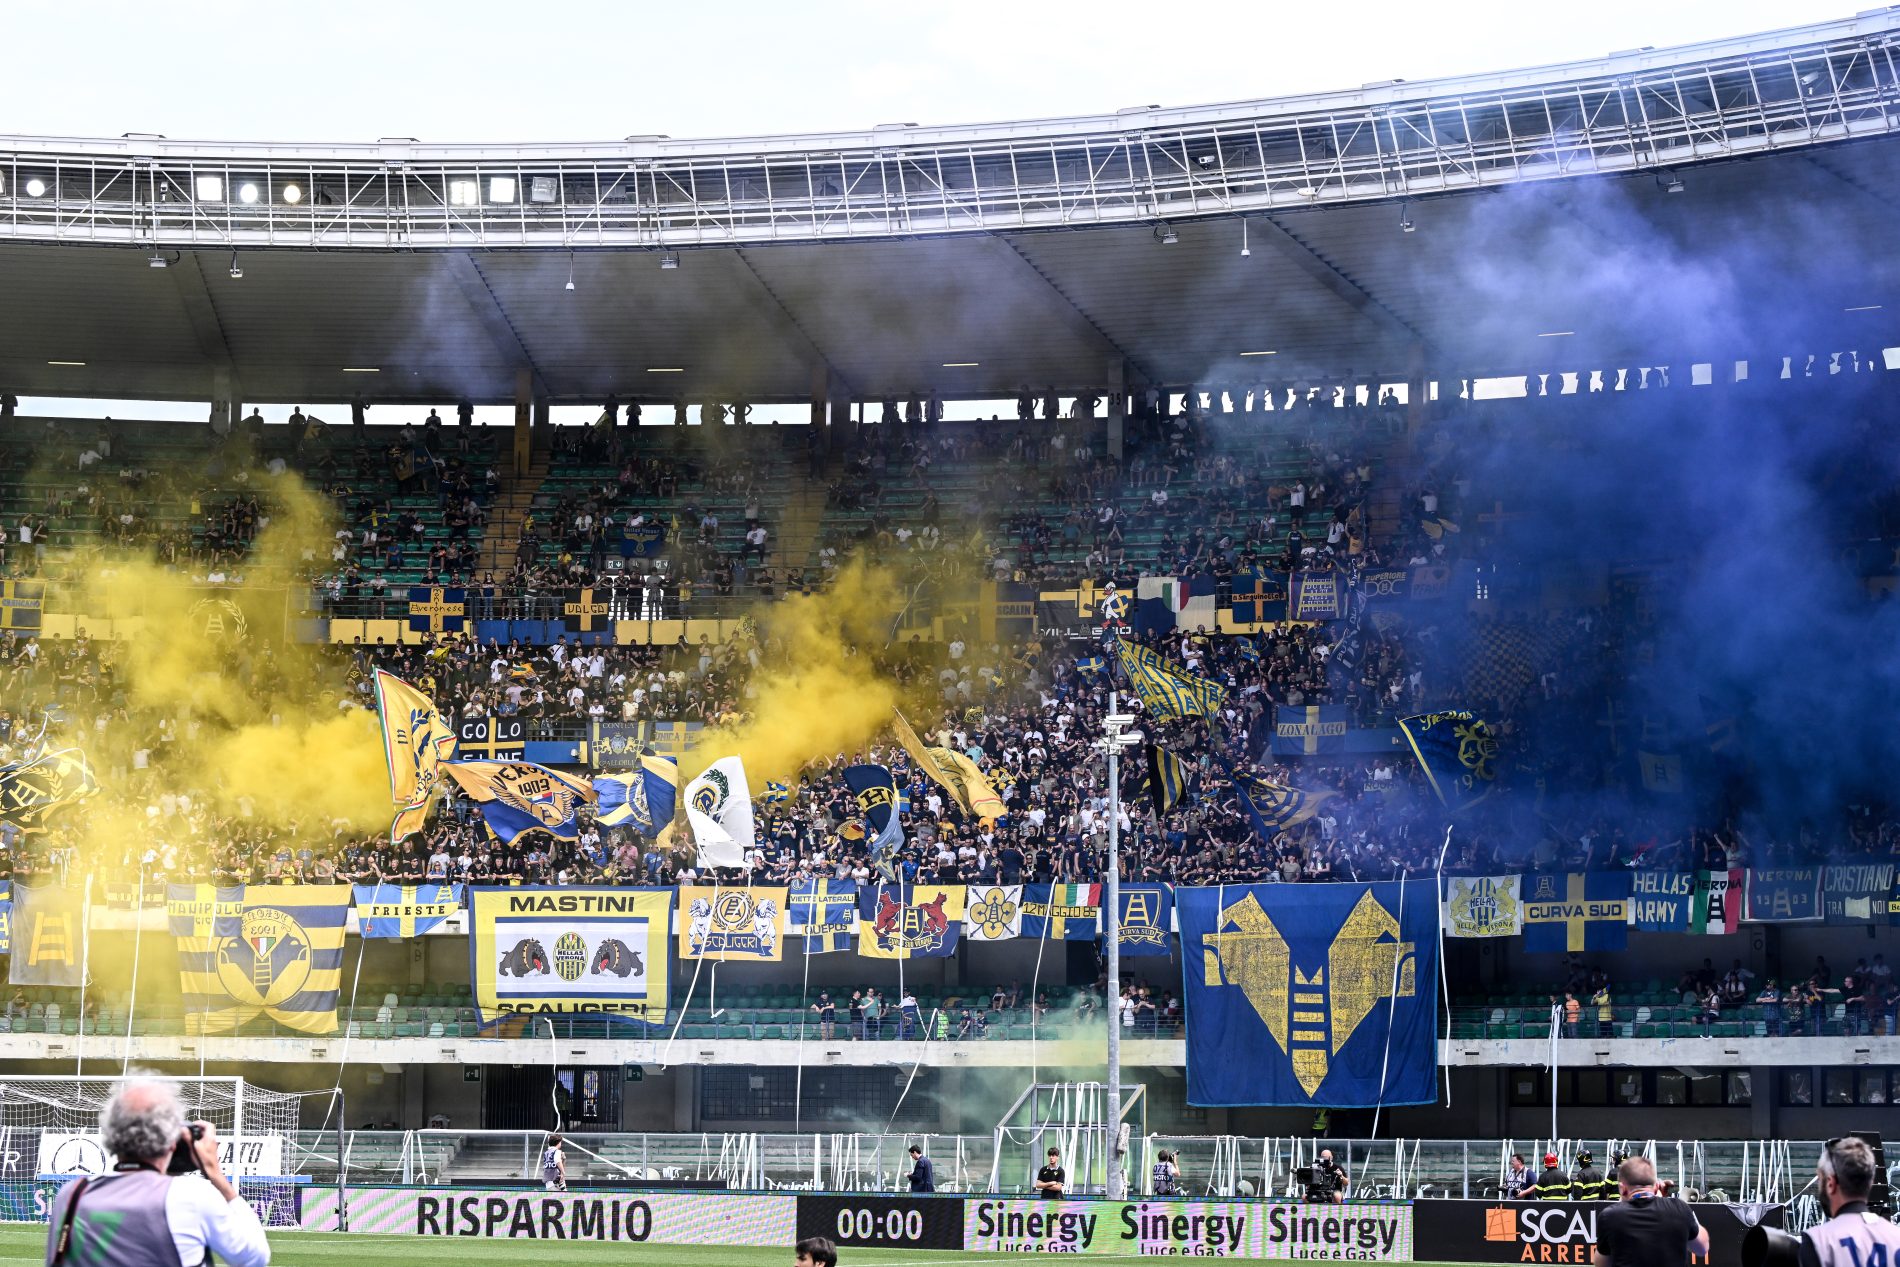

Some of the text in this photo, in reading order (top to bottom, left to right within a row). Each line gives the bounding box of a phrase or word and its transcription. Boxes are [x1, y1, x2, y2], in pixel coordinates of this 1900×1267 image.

[1366, 571, 1406, 581] SUPERIORE
[462, 723, 521, 739] GO LO
[518, 778, 551, 796] 1903
[1633, 871, 1692, 894] HELLAS
[1757, 869, 1812, 882] VERONA
[1824, 864, 1894, 892] CRISTIANO
[510, 896, 635, 912] MASTINI
[818, 895, 854, 903] LATERALI
[1470, 897, 1496, 908] HELLAS
[168, 902, 242, 915] MANIPOLO
[373, 905, 445, 916] TRIESTE
[1024, 902, 1097, 918] 12 MAGGIO 85
[1529, 903, 1622, 919] CURVA SUD
[1637, 900, 1677, 923] ARMY
[1827, 900, 1886, 915] TRA NOI
[804, 924, 847, 935] QUEPOS
[1118, 928, 1155, 936] CURVA SUD
[1456, 920, 1514, 933] HELLAS VERONA
[705, 935, 758, 949] SCALIGERI
[417, 1196, 653, 1241] RISPARMIO
[837, 1208, 923, 1240] 00:00
[977, 1201, 1097, 1249] Sinergy
[1120, 1203, 1245, 1250] Sinergy
[1269, 1205, 1398, 1254] Sinergy
[997, 1241, 1031, 1252] Luce
[1048, 1241, 1077, 1252] Gas
[1141, 1243, 1177, 1256] Luce
[1194, 1244, 1223, 1256] Gas
[1290, 1246, 1329, 1260] Luce
[1345, 1247, 1377, 1260] Gas
